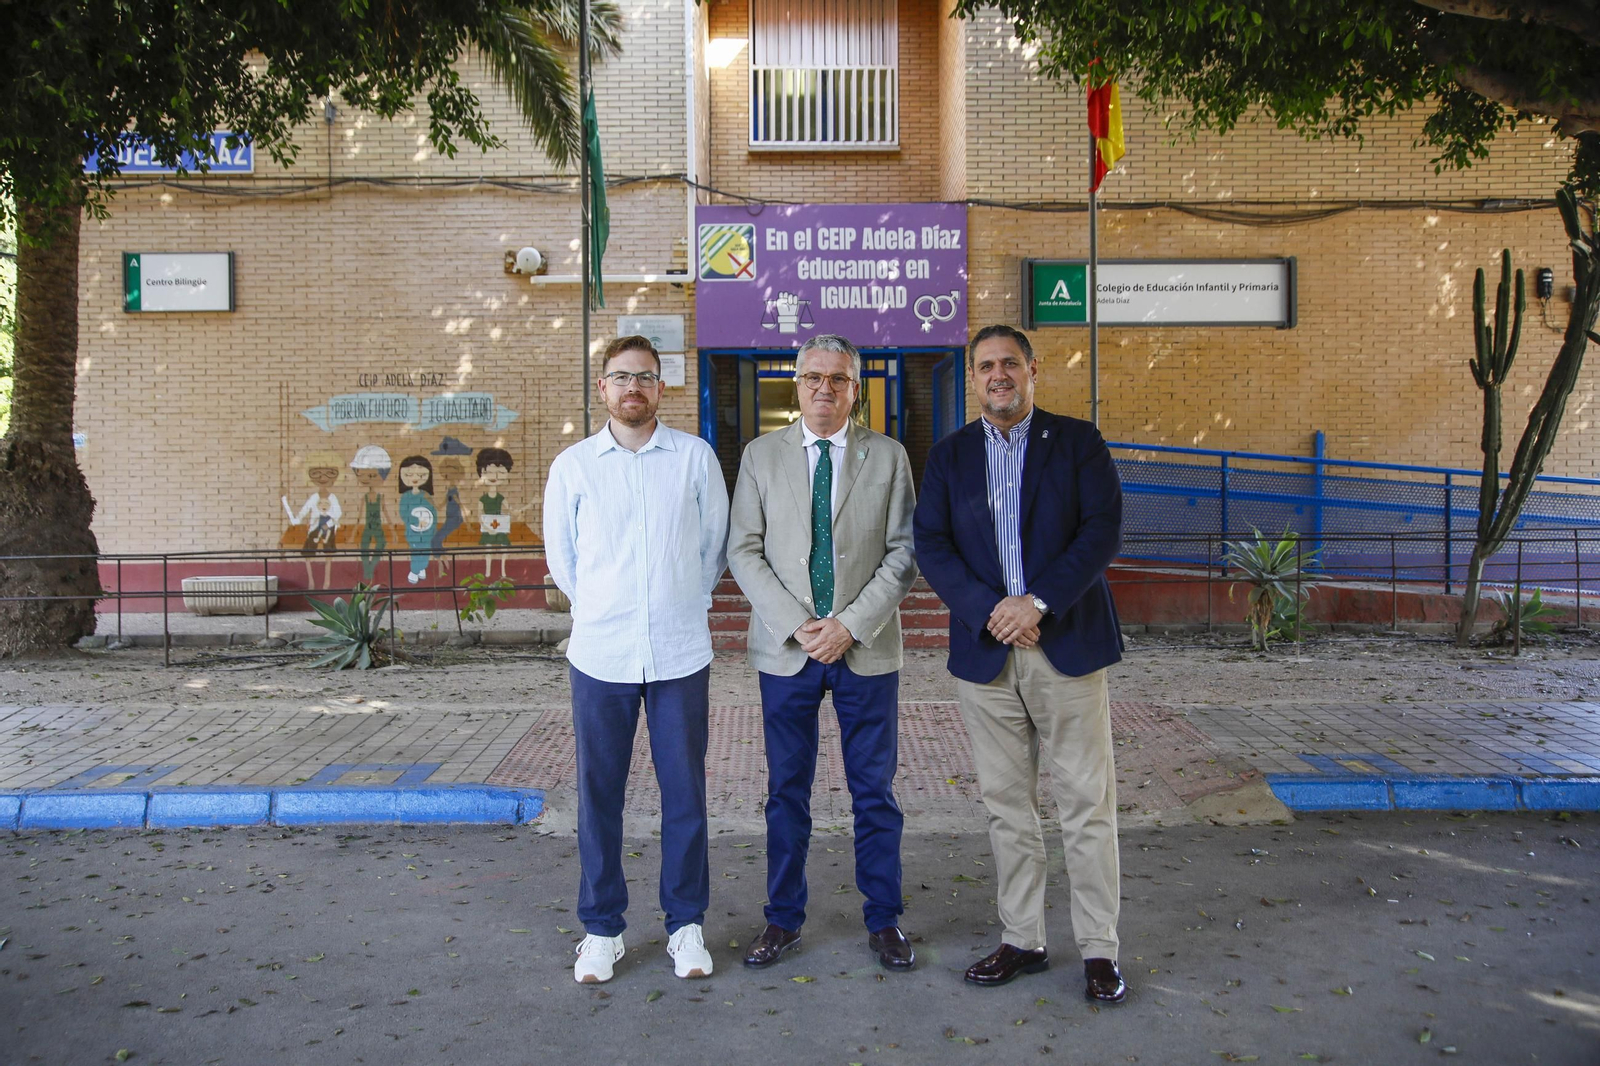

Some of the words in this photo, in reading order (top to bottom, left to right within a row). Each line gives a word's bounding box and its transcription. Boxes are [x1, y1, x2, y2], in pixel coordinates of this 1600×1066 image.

[766, 228, 788, 251] En
[794, 228, 812, 251] el
[817, 227, 857, 251] CEIP
[862, 227, 916, 250] Adela
[921, 224, 961, 250] Díaz
[797, 257, 900, 280] educamos
[905, 259, 930, 279] en
[174, 278, 207, 287] Bilingüe
[1096, 283, 1131, 294] Colegio
[1132, 283, 1145, 292] de
[1146, 282, 1194, 292] Educación
[1196, 282, 1230, 292] Infantil
[1231, 284, 1238, 294] y
[1239, 282, 1279, 292] Primaria
[820, 286, 907, 310] IGUALDAD
[385, 373, 414, 387] ADELA
[368, 398, 408, 418] FUTURO
